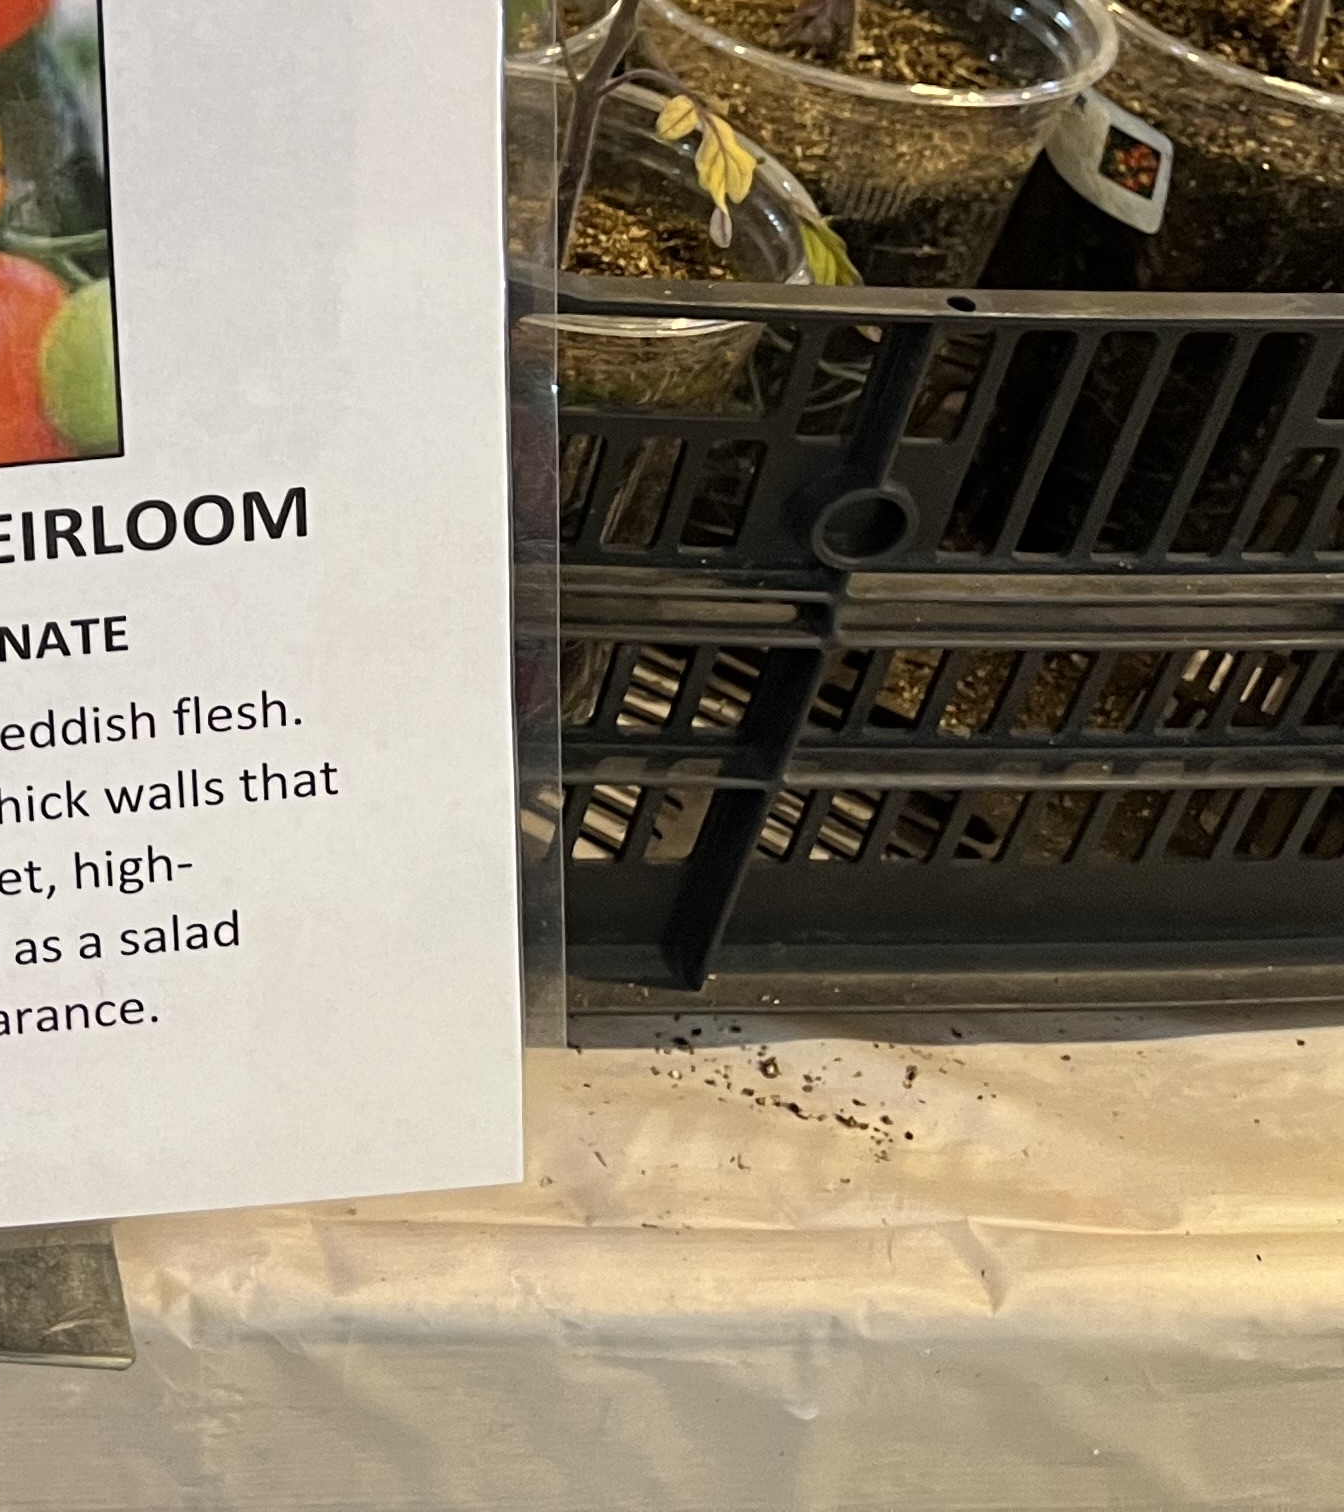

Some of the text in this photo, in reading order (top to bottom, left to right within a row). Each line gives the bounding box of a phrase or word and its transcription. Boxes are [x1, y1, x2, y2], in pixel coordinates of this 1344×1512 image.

[171, 689, 302, 736] flesh.
[103, 767, 224, 814] walls
[238, 761, 339, 803] that
[73, 843, 193, 895] high-
[14, 935, 62, 965] as
[78, 931, 102, 960] a
[119, 908, 239, 956] salad
